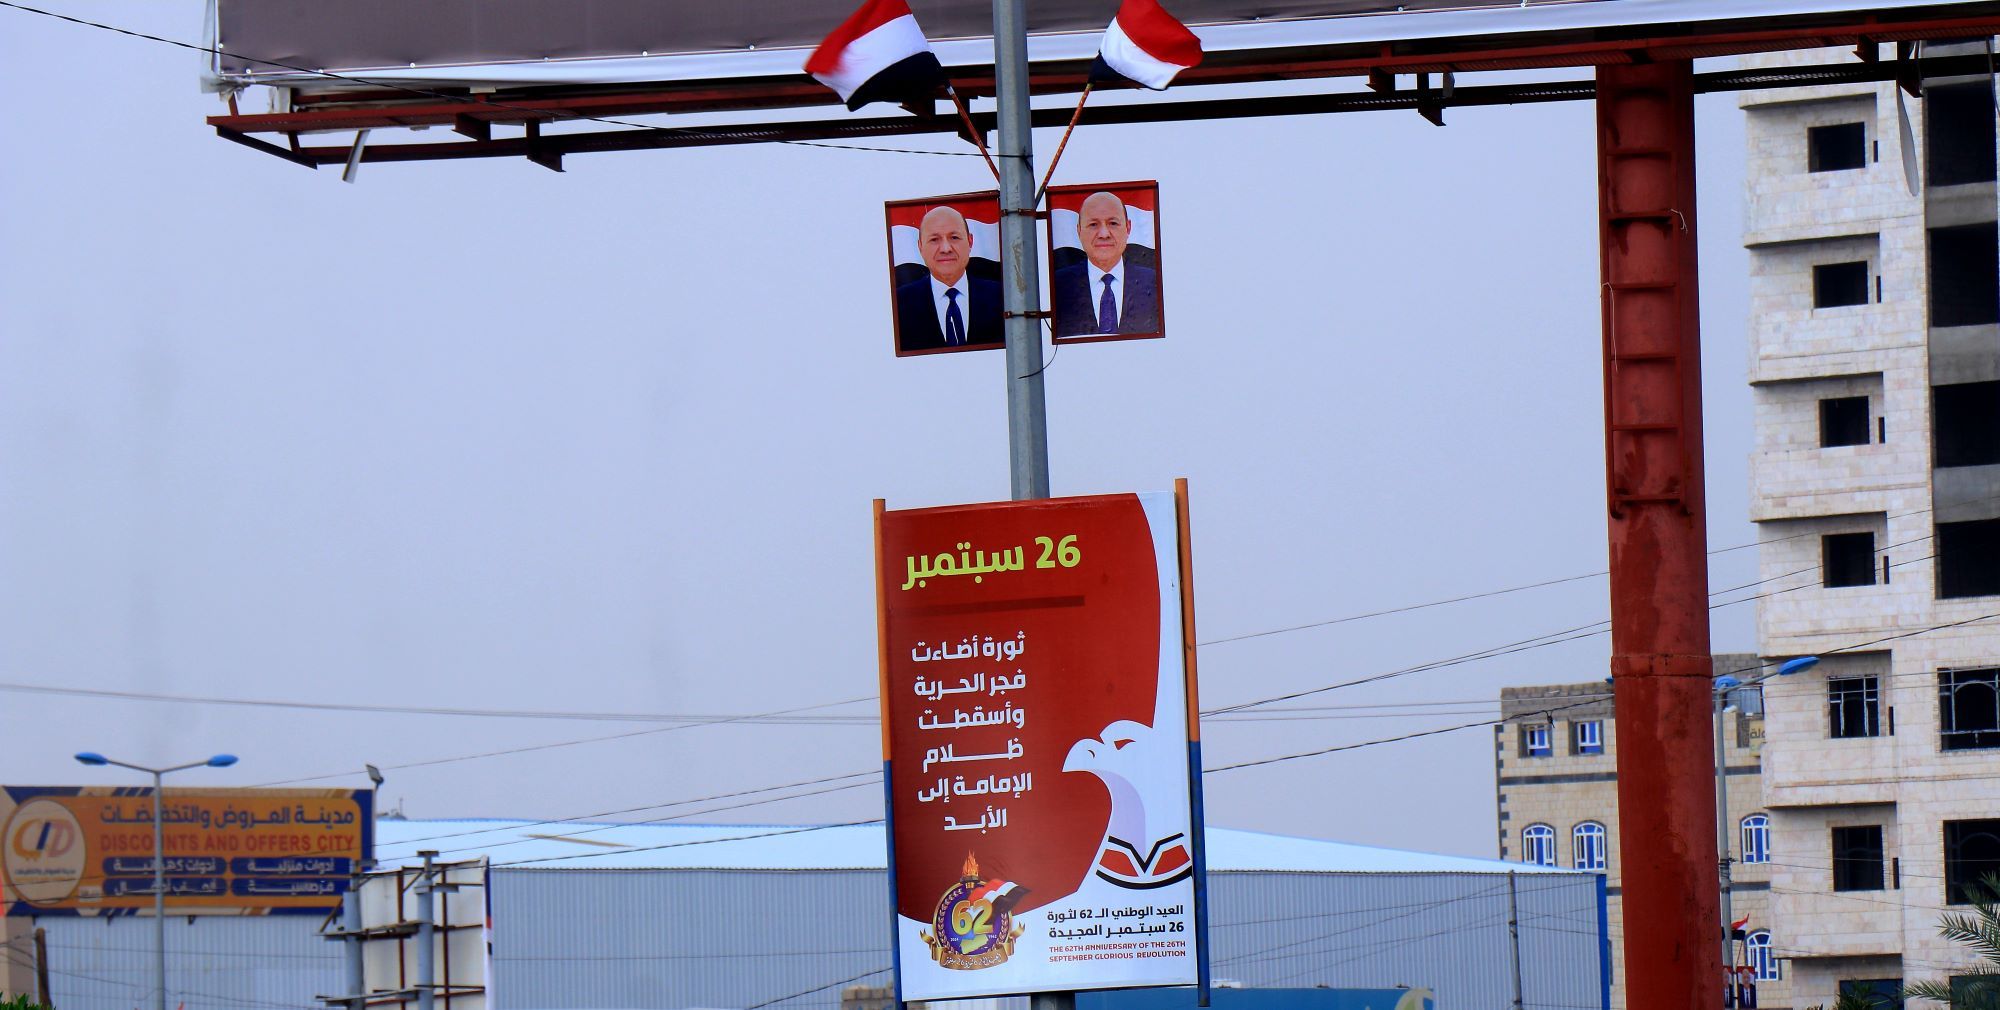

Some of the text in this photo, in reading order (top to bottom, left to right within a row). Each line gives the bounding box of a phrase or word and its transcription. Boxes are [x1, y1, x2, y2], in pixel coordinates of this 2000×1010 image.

[901, 535, 1081, 591] 26 سبتمبر
[911, 630, 1026, 662] ثورة أضاءت
[914, 668, 1026, 701] فجر الحرية
[918, 701, 1025, 730] وأسقطت
[922, 737, 1024, 774] ظلام
[917, 772, 1032, 803] الإمامة إلى
[214, 804, 291, 830] العروض
[294, 804, 355, 830] مدينة
[943, 805, 1007, 835] الأبد
[100, 834, 355, 852] DISCONTS AND OFFERS CITY
[951, 898, 994, 936] 62
[1047, 908, 1077, 924] لثورة
[1079, 908, 1093, 919] 62
[1111, 905, 1154, 920] الوطني
[1155, 904, 1184, 918] العيد
[1048, 921, 1185, 940] 26 سبتمبر المجيدة
[1049, 945, 1064, 953] THE
[1065, 945, 1084, 953] 62TH
[1085, 942, 1137, 951] ANNIVERSARY
[1151, 941, 1165, 949] THE
[1166, 940, 1186, 948] 26TH
[1049, 950, 1186, 963] SEPTEMBER GLORIOUS REVOLUTION
